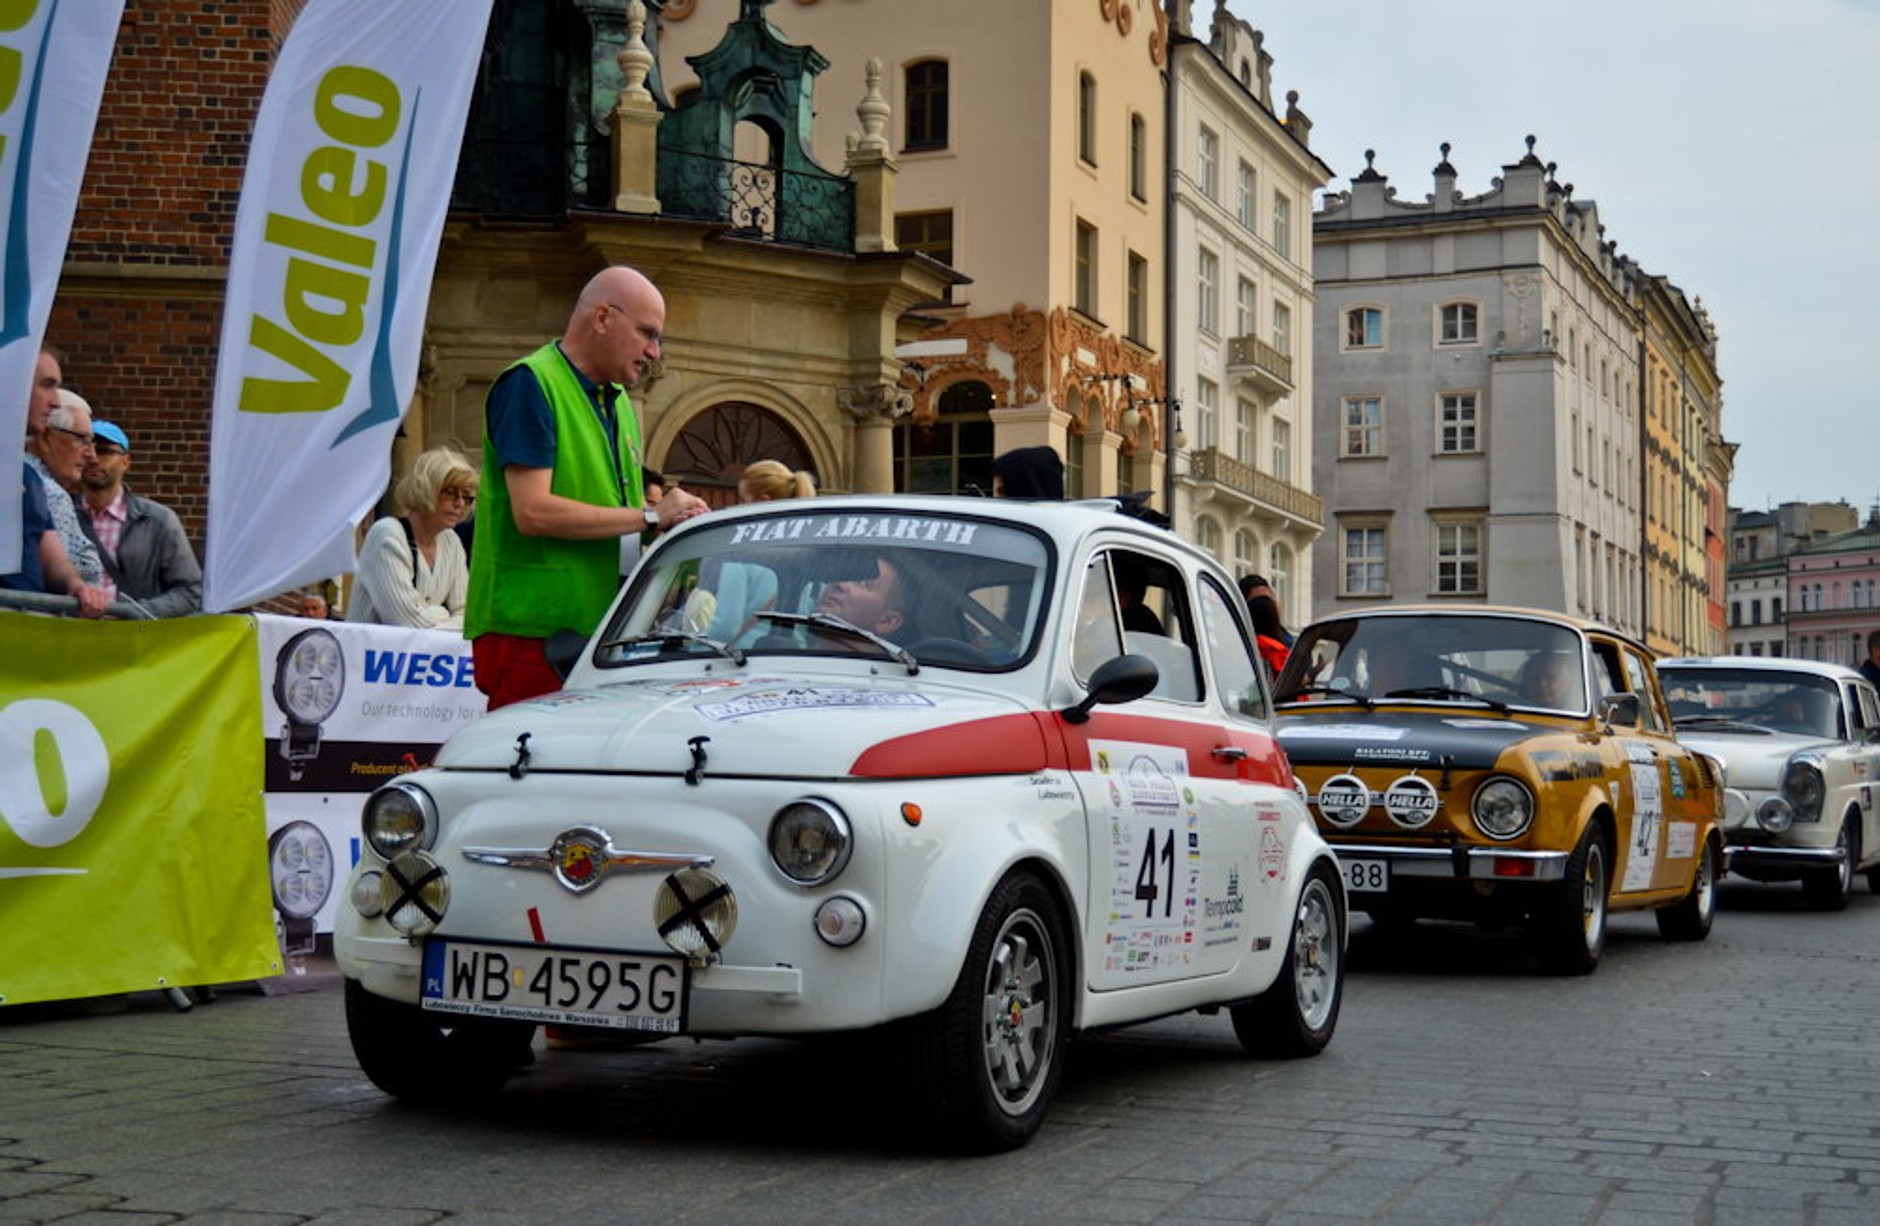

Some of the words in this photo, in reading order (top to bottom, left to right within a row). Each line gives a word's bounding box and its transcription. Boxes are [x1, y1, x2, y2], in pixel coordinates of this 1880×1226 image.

[239, 64, 402, 414] Valeo
[730, 518, 812, 544] FIAT
[815, 517, 979, 545] ABARTH
[365, 650, 475, 688] WESE
[361, 701, 384, 716] Our
[386, 702, 454, 721] technology
[351, 762, 398, 774] Producent
[1322, 793, 1365, 807] HELLA
[1390, 794, 1434, 809] HELLA
[1135, 828, 1174, 918] 41
[427, 978, 441, 992] PL
[452, 950, 510, 1001] WB
[529, 957, 676, 1014] 4595G
[474, 1005, 498, 1015] Firma
[566, 1013, 610, 1026] Warszawa
